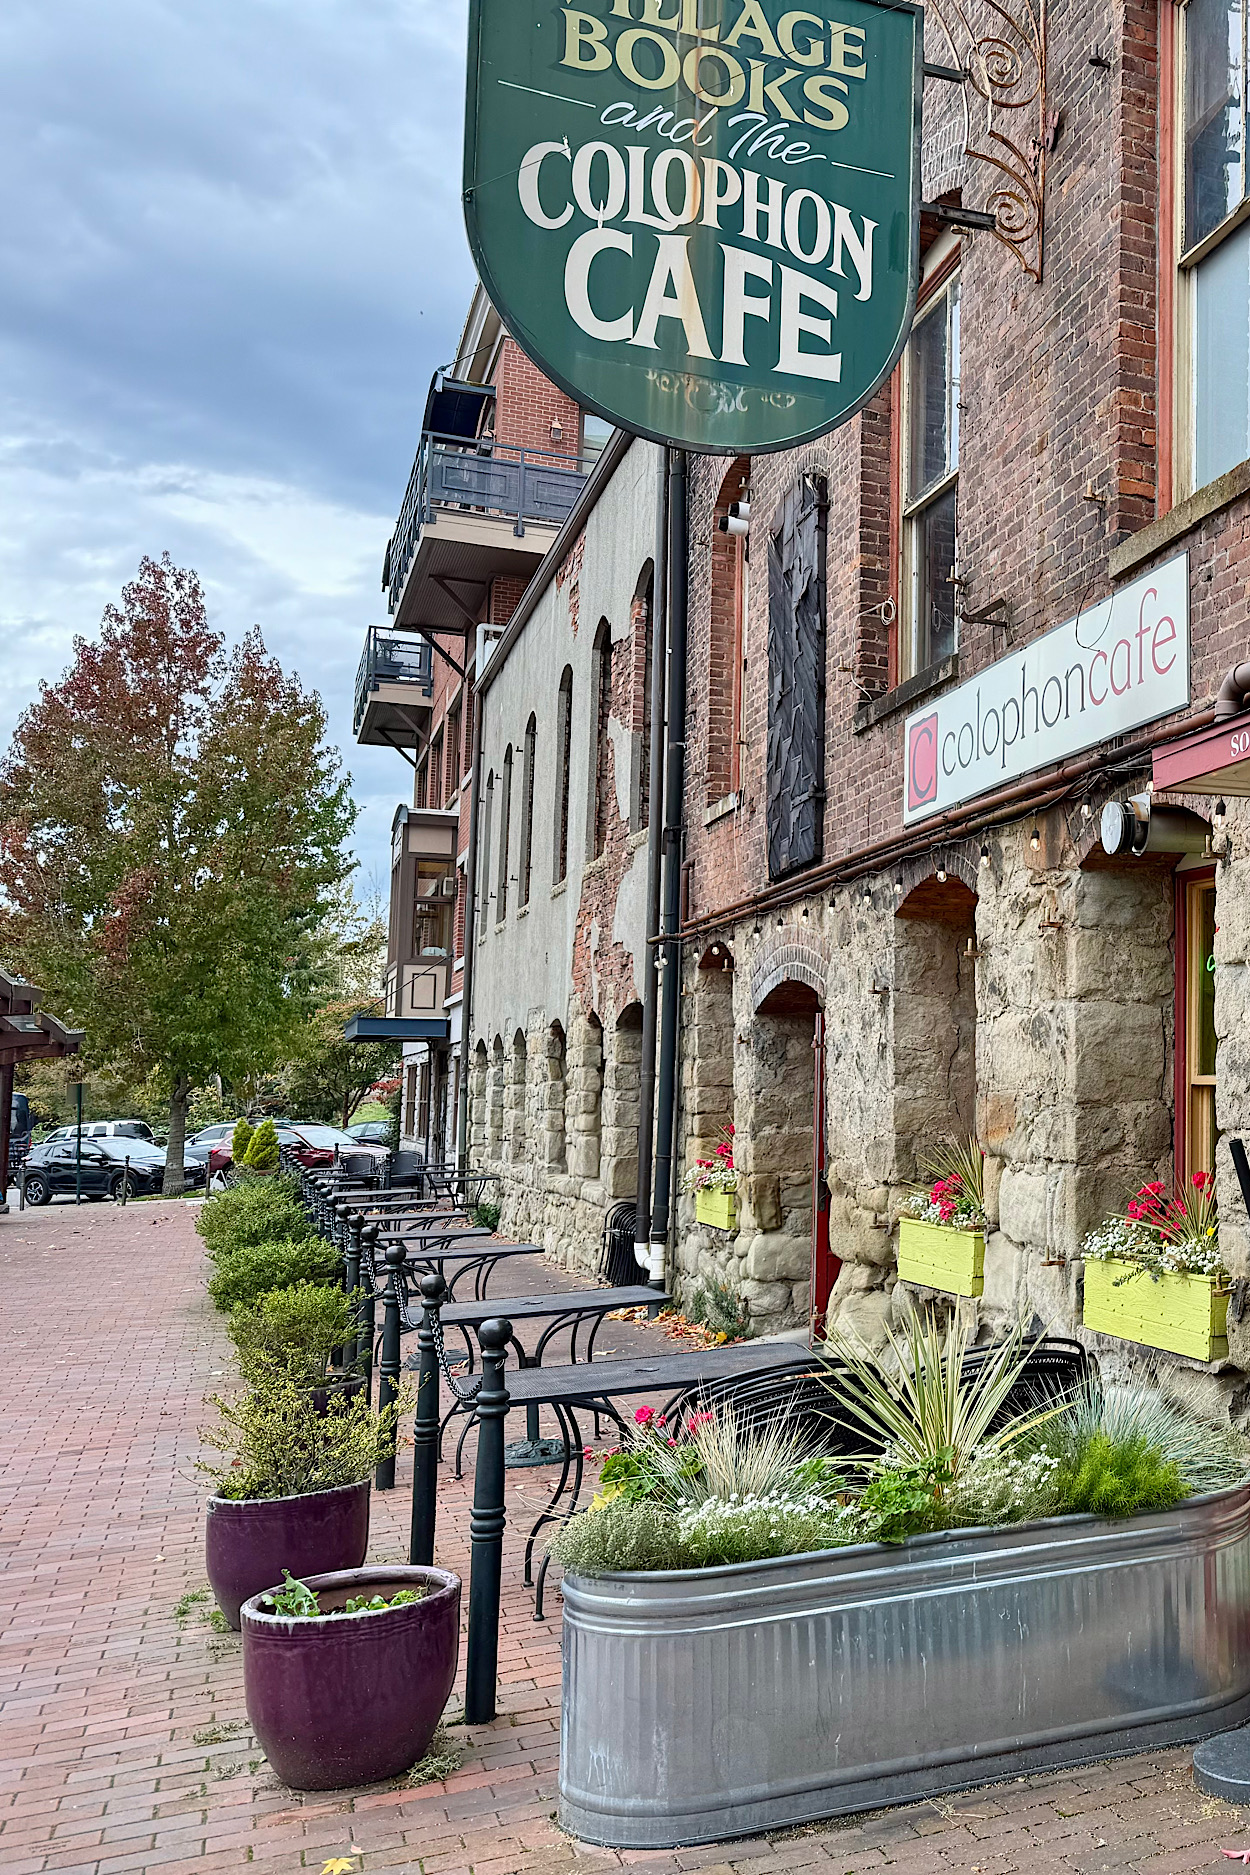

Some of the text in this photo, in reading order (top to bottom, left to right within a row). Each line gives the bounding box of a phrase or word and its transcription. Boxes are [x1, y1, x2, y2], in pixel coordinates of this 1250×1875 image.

[560, 7, 850, 132] BOOKS
[600, 101, 827, 165] and The
[518, 140, 880, 302] COLOPHON
[564, 226, 842, 383] CAFE
